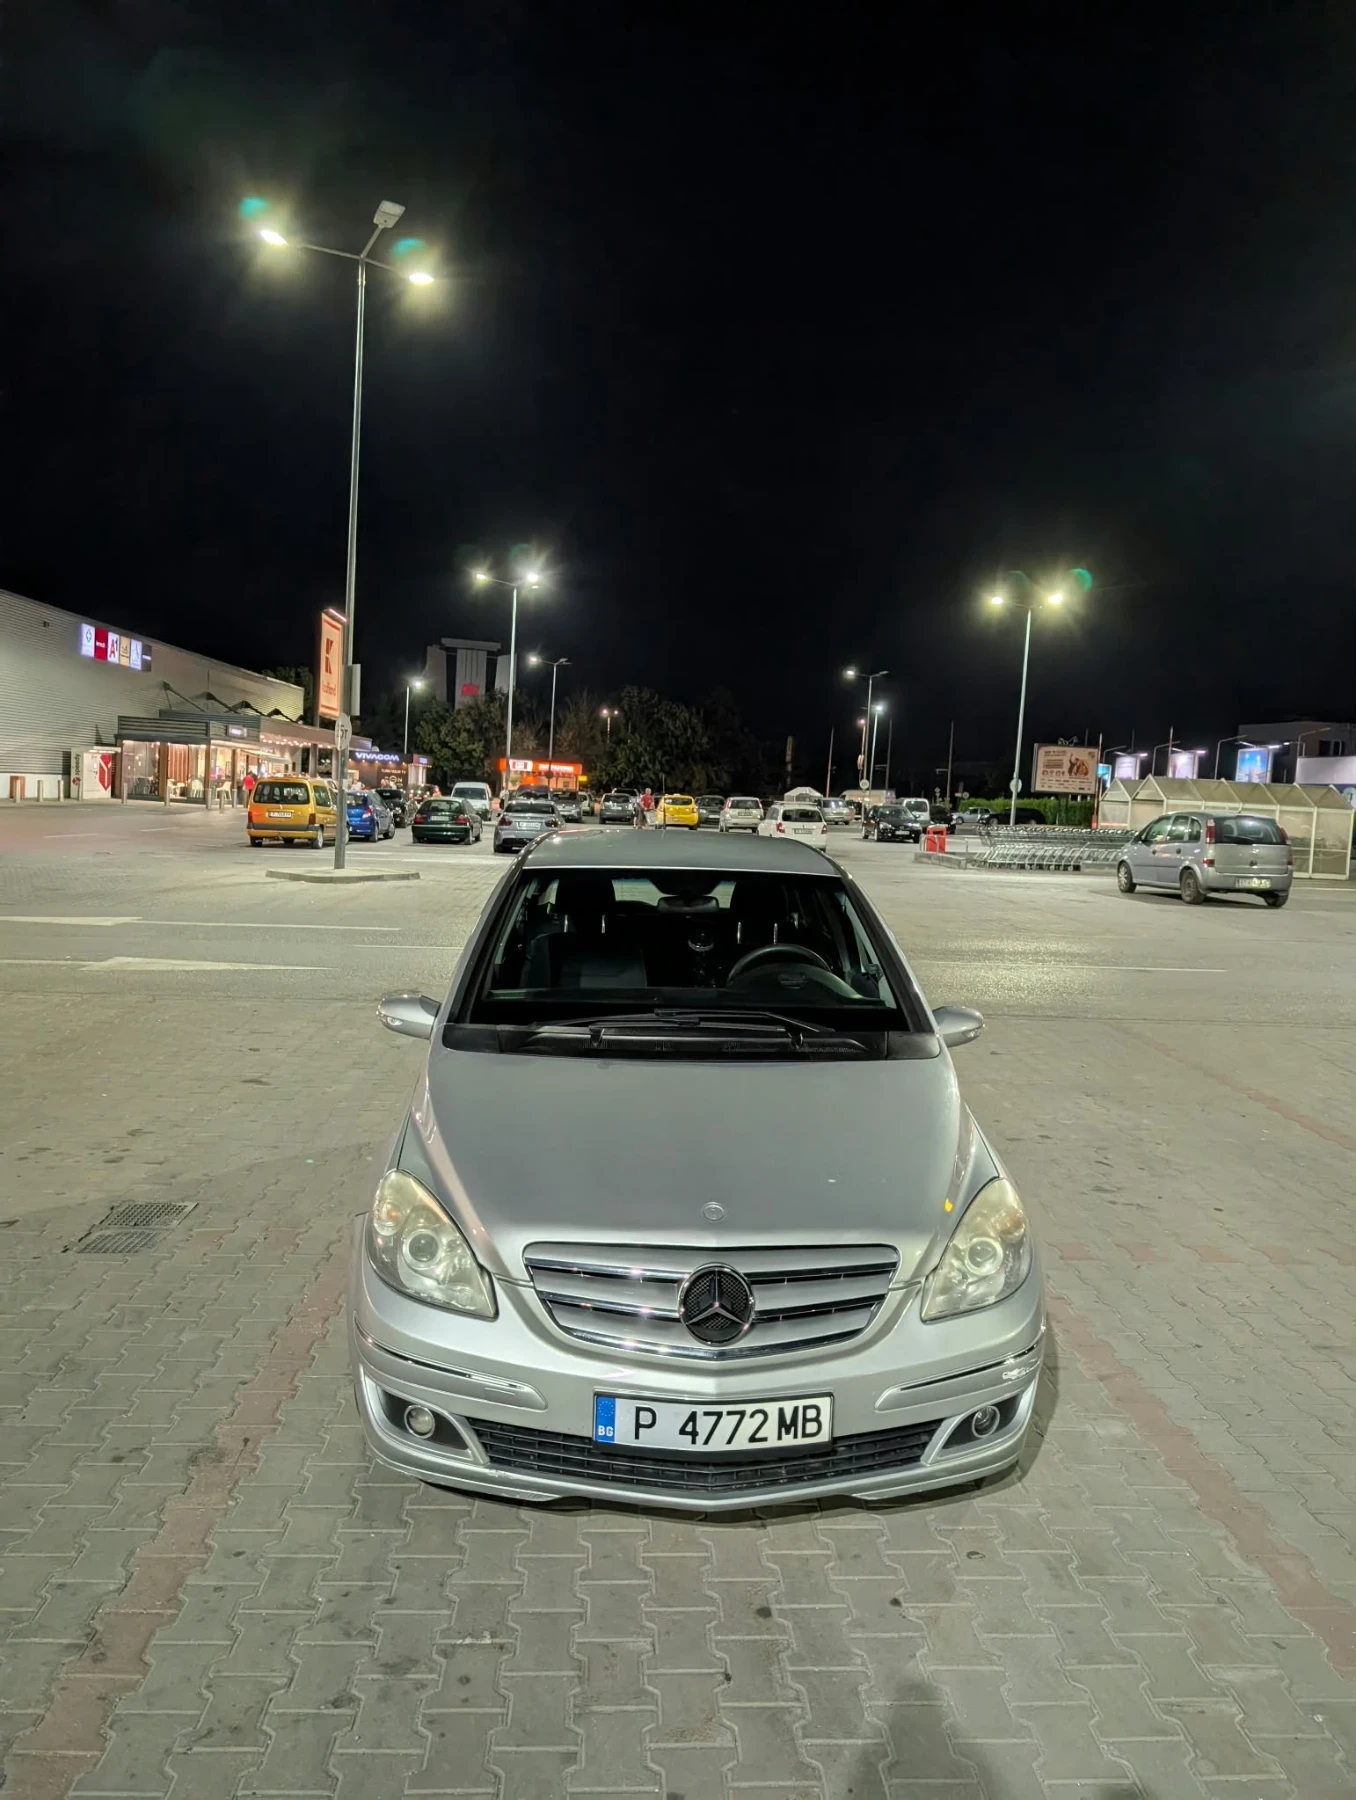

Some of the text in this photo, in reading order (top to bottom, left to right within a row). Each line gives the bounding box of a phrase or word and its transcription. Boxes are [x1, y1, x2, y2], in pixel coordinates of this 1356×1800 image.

[109, 637, 118, 659] A1
[325, 637, 333, 675] K
[355, 752, 399, 762] VIVACOM
[598, 1425, 614, 1437] BG
[634, 1406, 657, 1440] P
